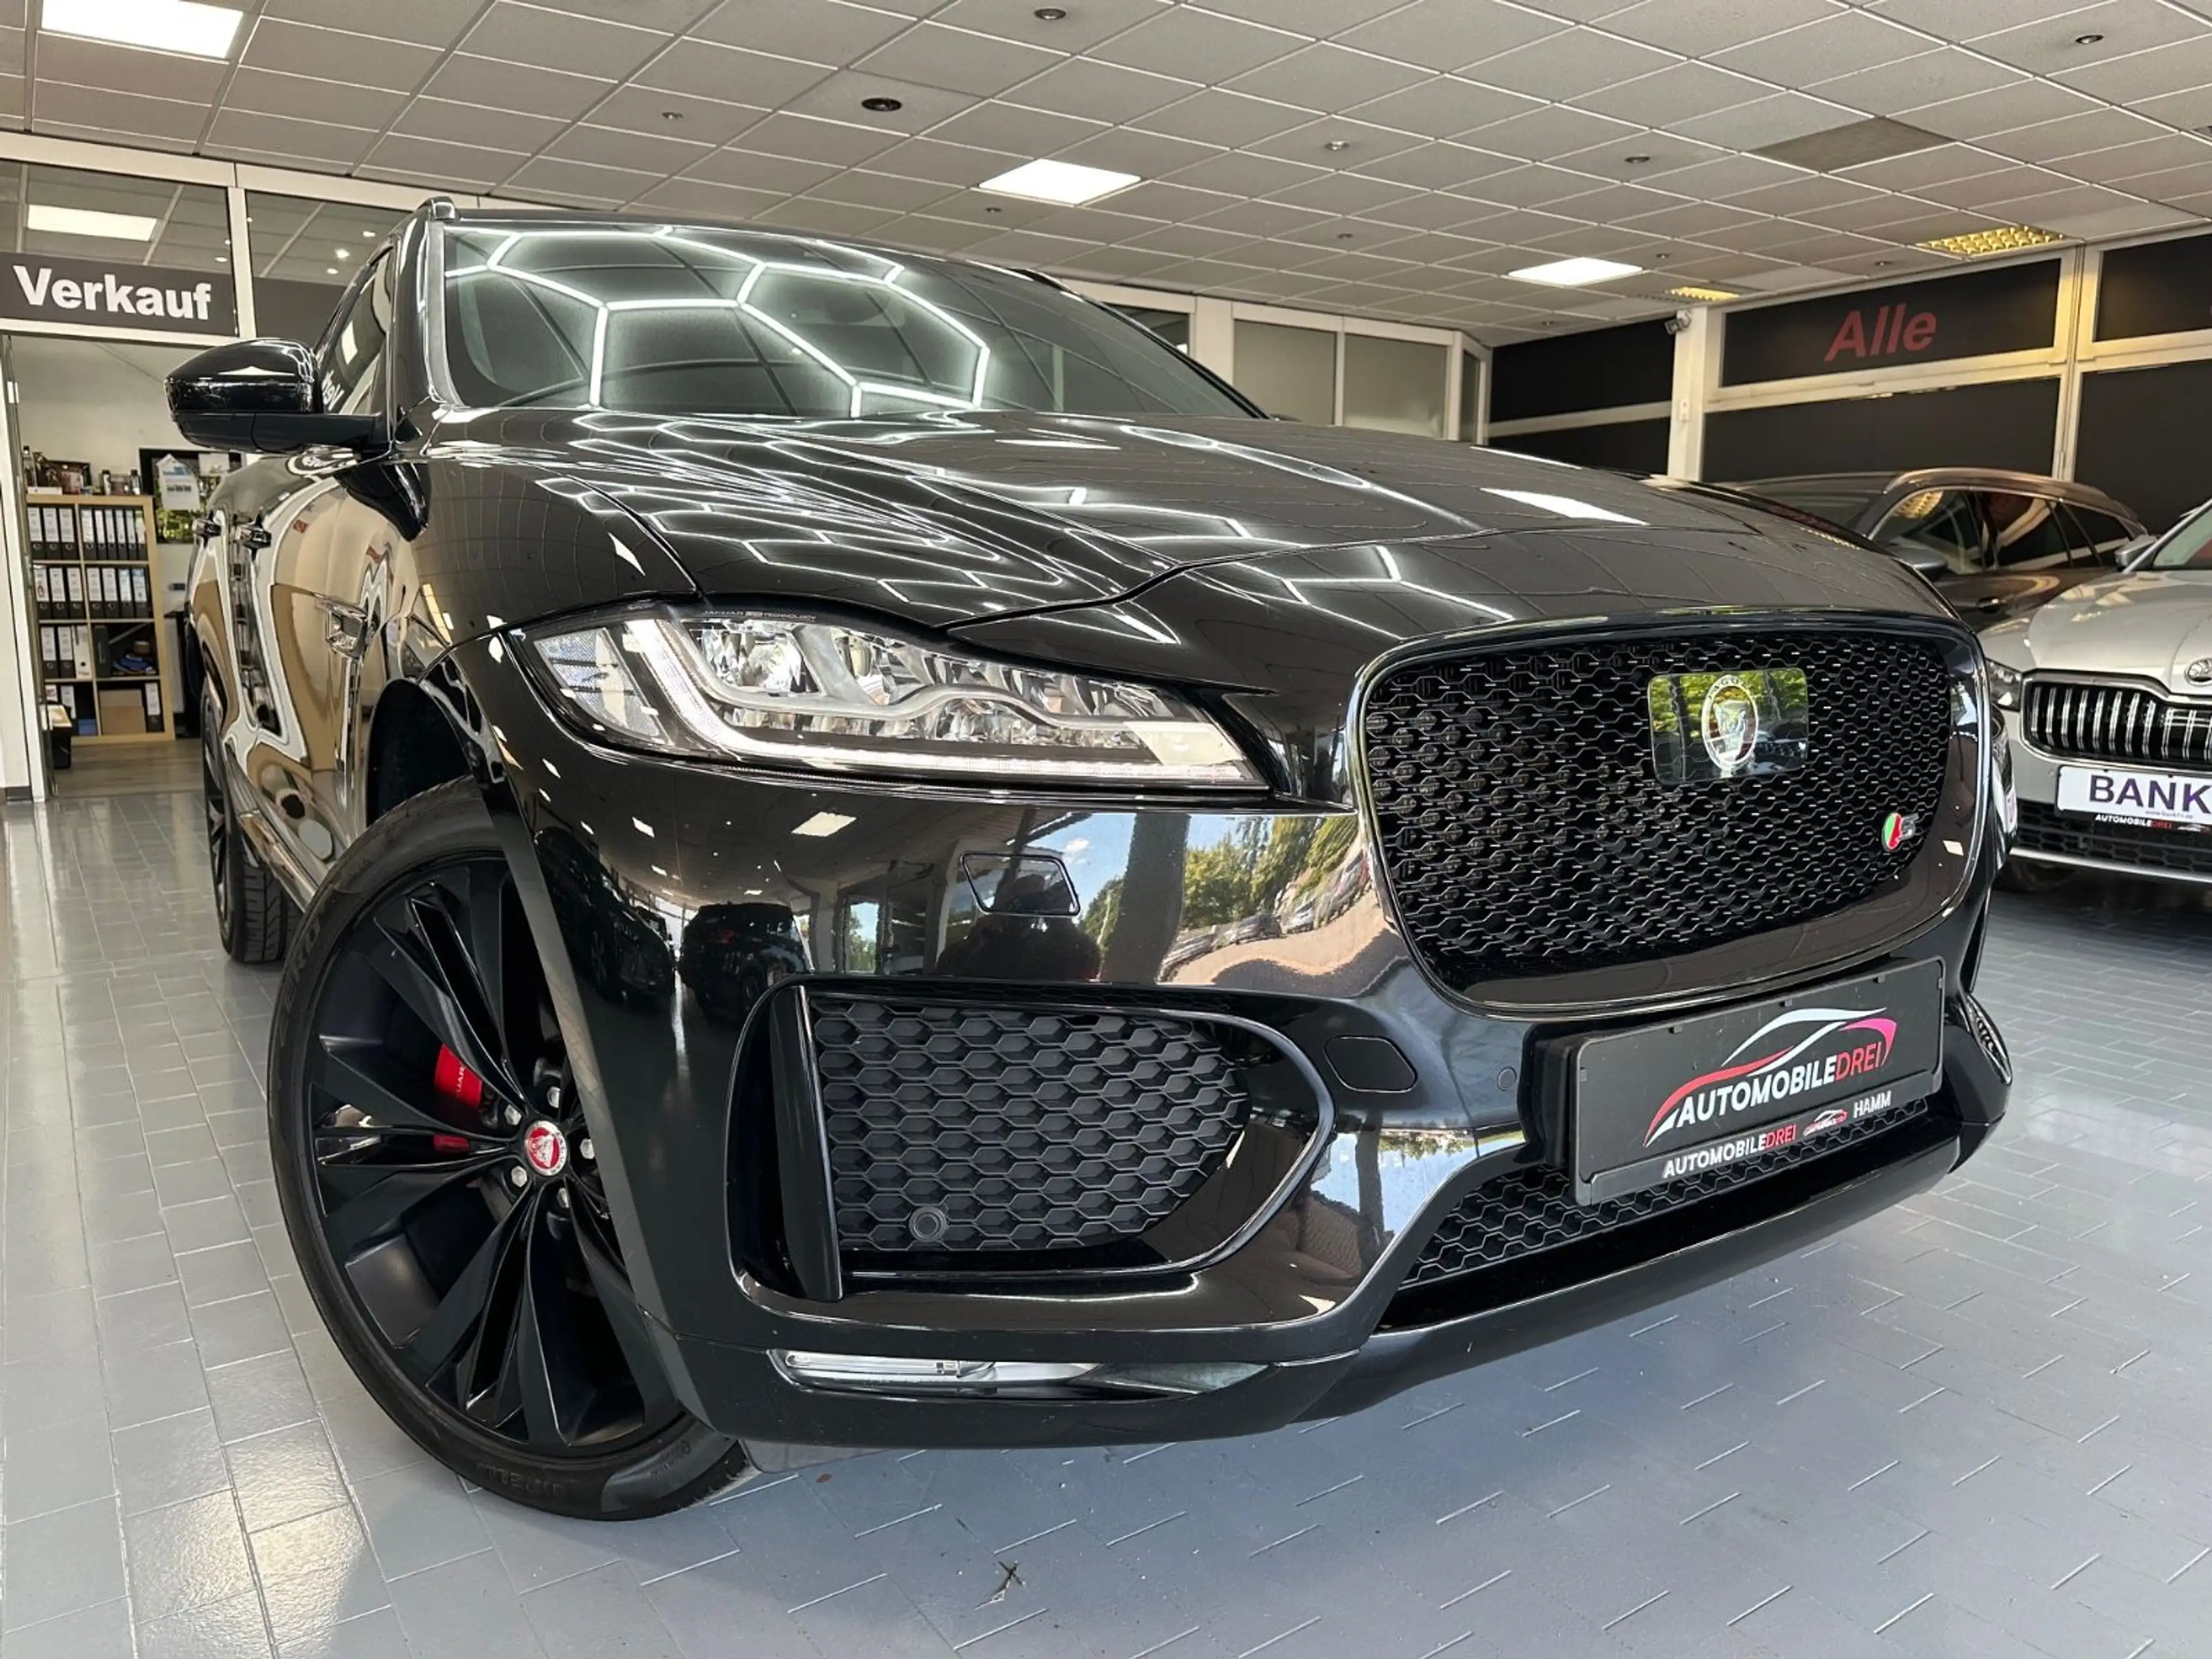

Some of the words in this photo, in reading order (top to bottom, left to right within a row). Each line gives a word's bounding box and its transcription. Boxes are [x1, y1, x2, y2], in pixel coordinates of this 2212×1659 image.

[13, 265, 211, 320] Verkauf
[1824, 302, 1937, 362] Alle
[2089, 774, 2212, 814] BANK
[2095, 814, 2172, 829] AUTOMOBILEDREI
[1677, 1041, 1882, 1129] AUTOMOBILEDREI
[1662, 1124, 1796, 1179] AUTOMOBILEDREI
[1853, 1090, 1892, 1119] HAMM
